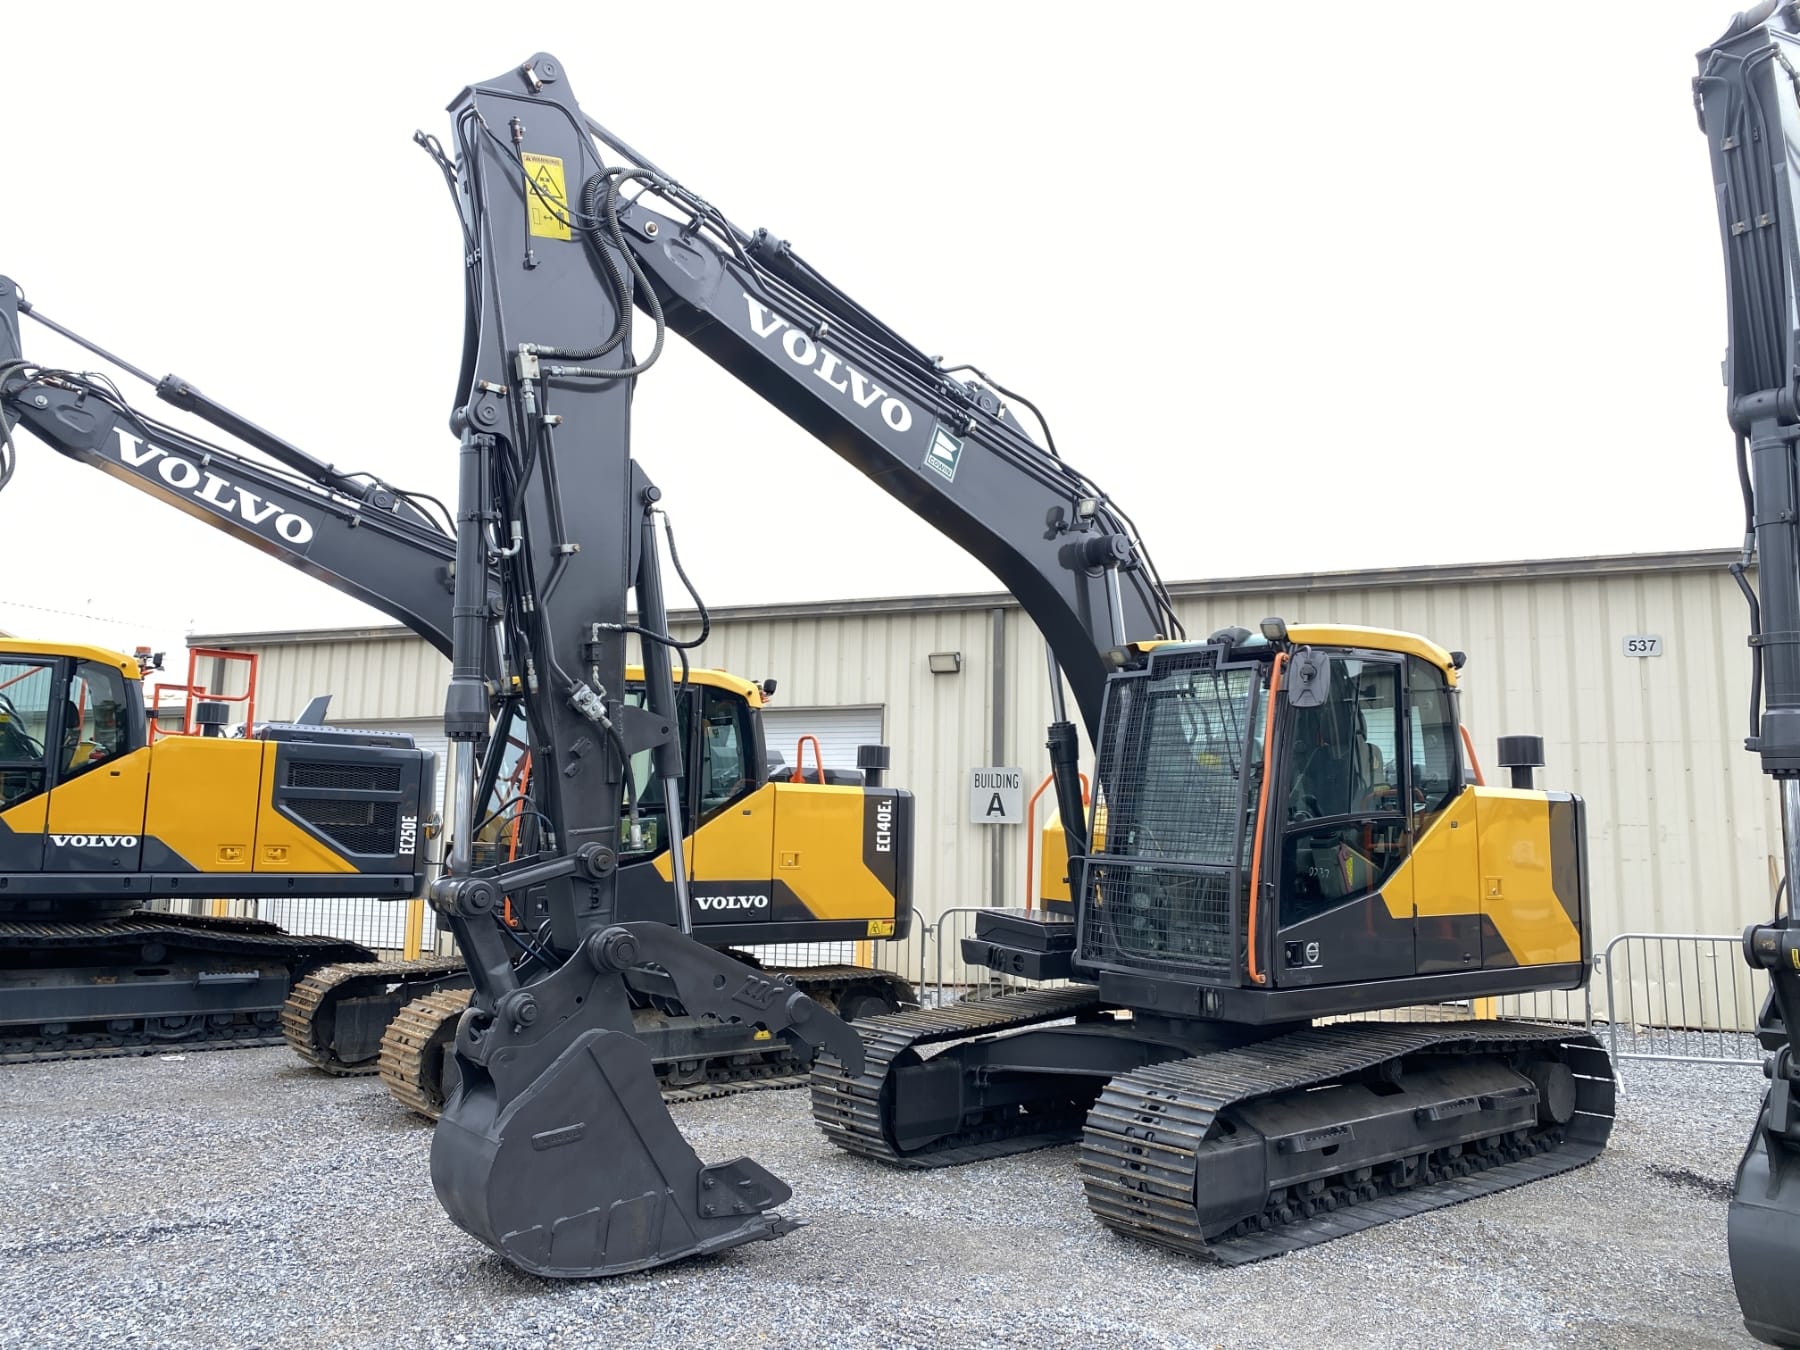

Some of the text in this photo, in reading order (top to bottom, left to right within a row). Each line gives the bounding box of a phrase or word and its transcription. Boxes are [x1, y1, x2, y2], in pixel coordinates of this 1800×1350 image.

[743, 292, 913, 432] VOLVO
[112, 426, 314, 544] VOLVO
[1628, 639, 1657, 652] 537
[974, 773, 1019, 789] BUILDING
[985, 792, 1006, 817] A
[49, 835, 138, 848] VOLVO
[398, 815, 418, 855] EC250E
[695, 895, 768, 910] VOLVO
